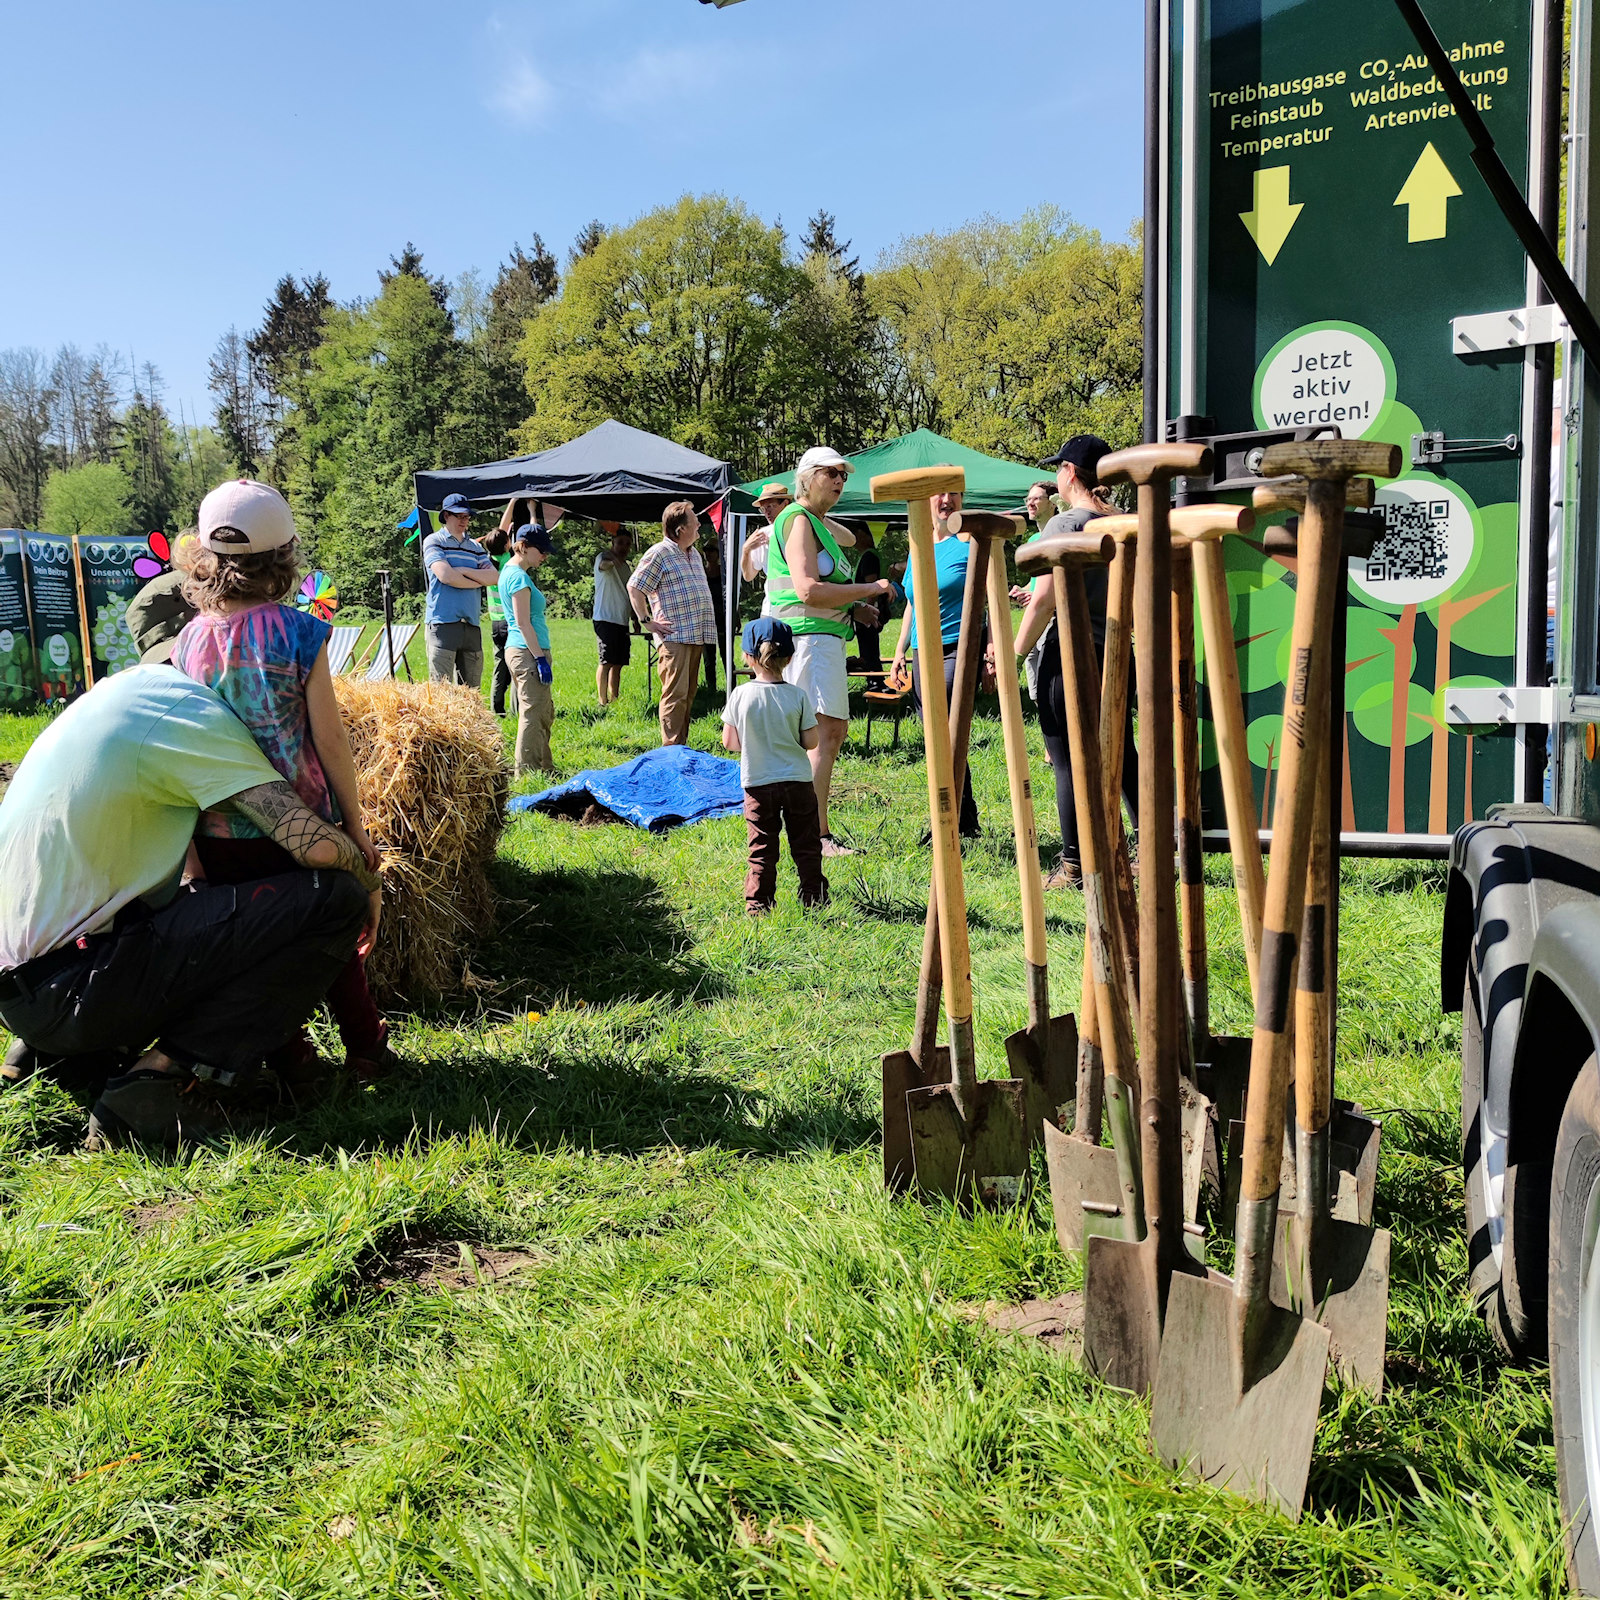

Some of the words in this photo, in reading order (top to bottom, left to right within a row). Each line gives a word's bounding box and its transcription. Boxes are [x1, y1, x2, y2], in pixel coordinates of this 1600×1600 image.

[1209, 70, 1347, 108] Treibhausgase
[1350, 66, 1508, 108] Waldbedekung
[1230, 98, 1324, 130] Feinstaub
[1221, 126, 1333, 158] Temperatur
[1291, 350, 1353, 373] Jetzt
[1292, 376, 1351, 399] aktiv
[1273, 400, 1369, 426] werden!
[91, 568, 120, 577] Unsere
[1292, 647, 1312, 706] GARDENER
